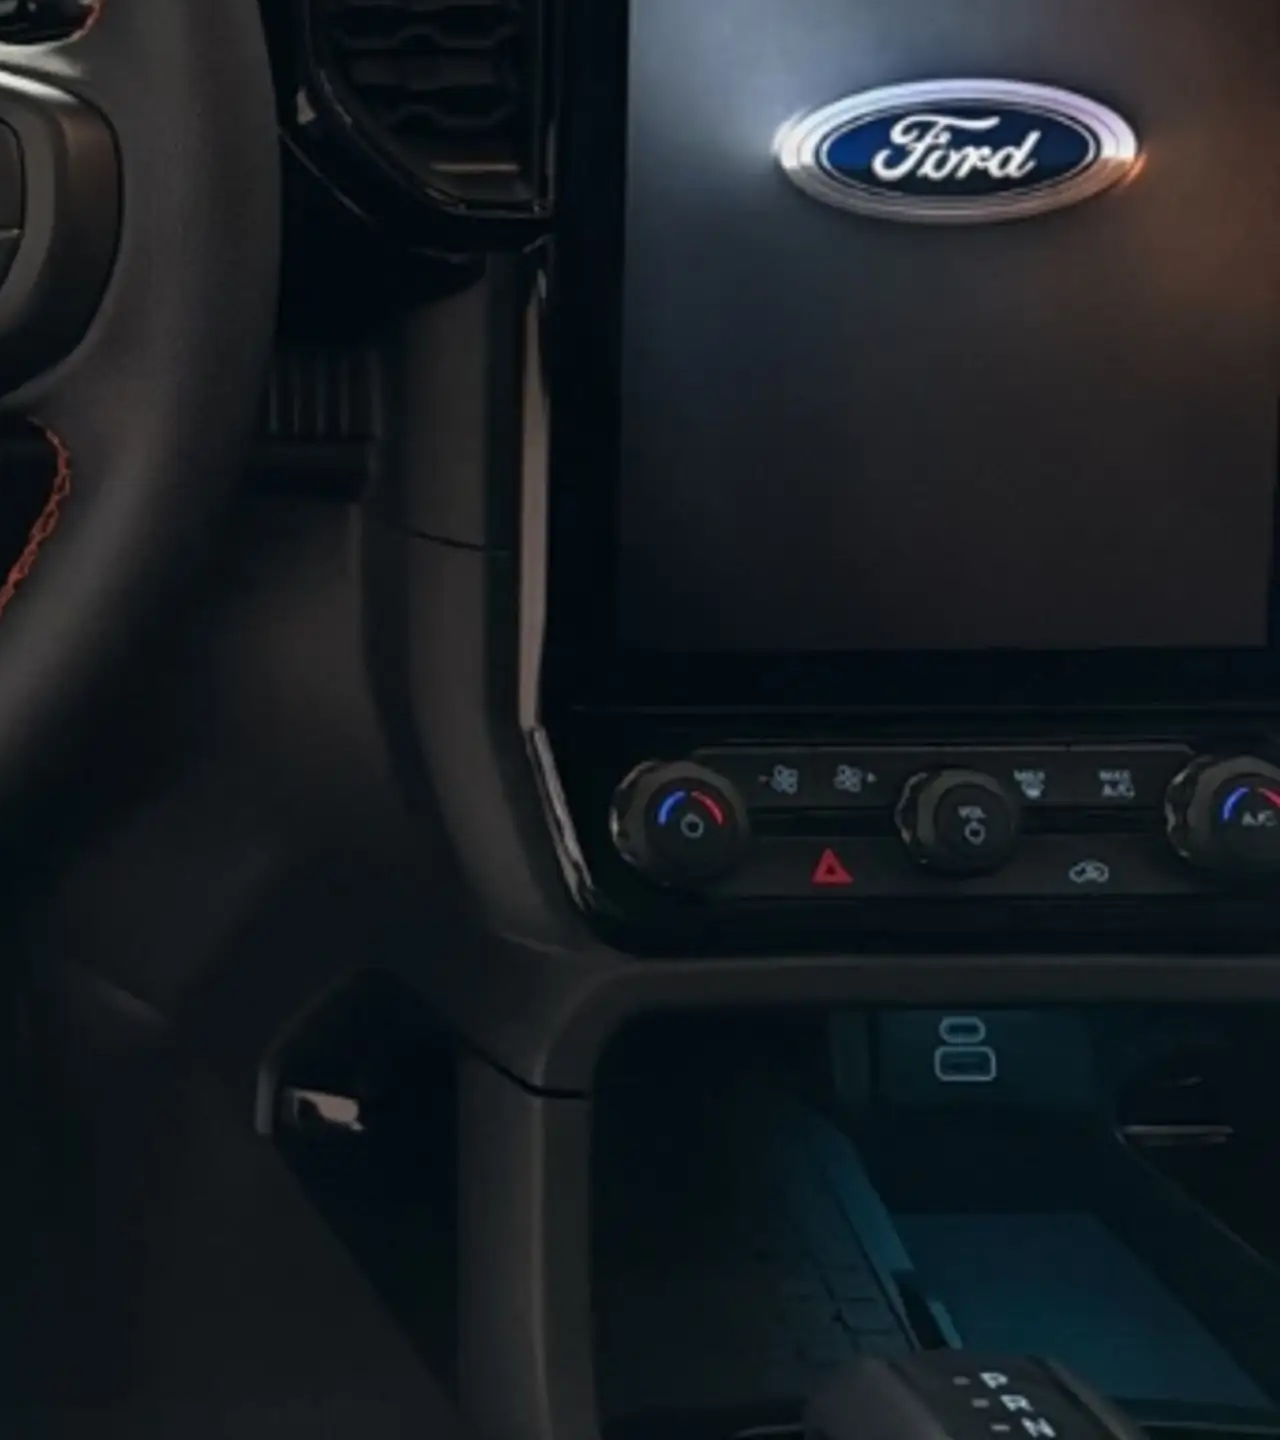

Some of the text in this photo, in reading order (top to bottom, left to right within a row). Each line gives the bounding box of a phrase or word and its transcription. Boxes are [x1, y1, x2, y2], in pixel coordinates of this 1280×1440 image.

[871, 114, 1042, 181] Ford
[979, 1371, 1009, 1390] P
[1000, 1393, 1035, 1413] R
[1021, 1416, 1057, 1438] N
